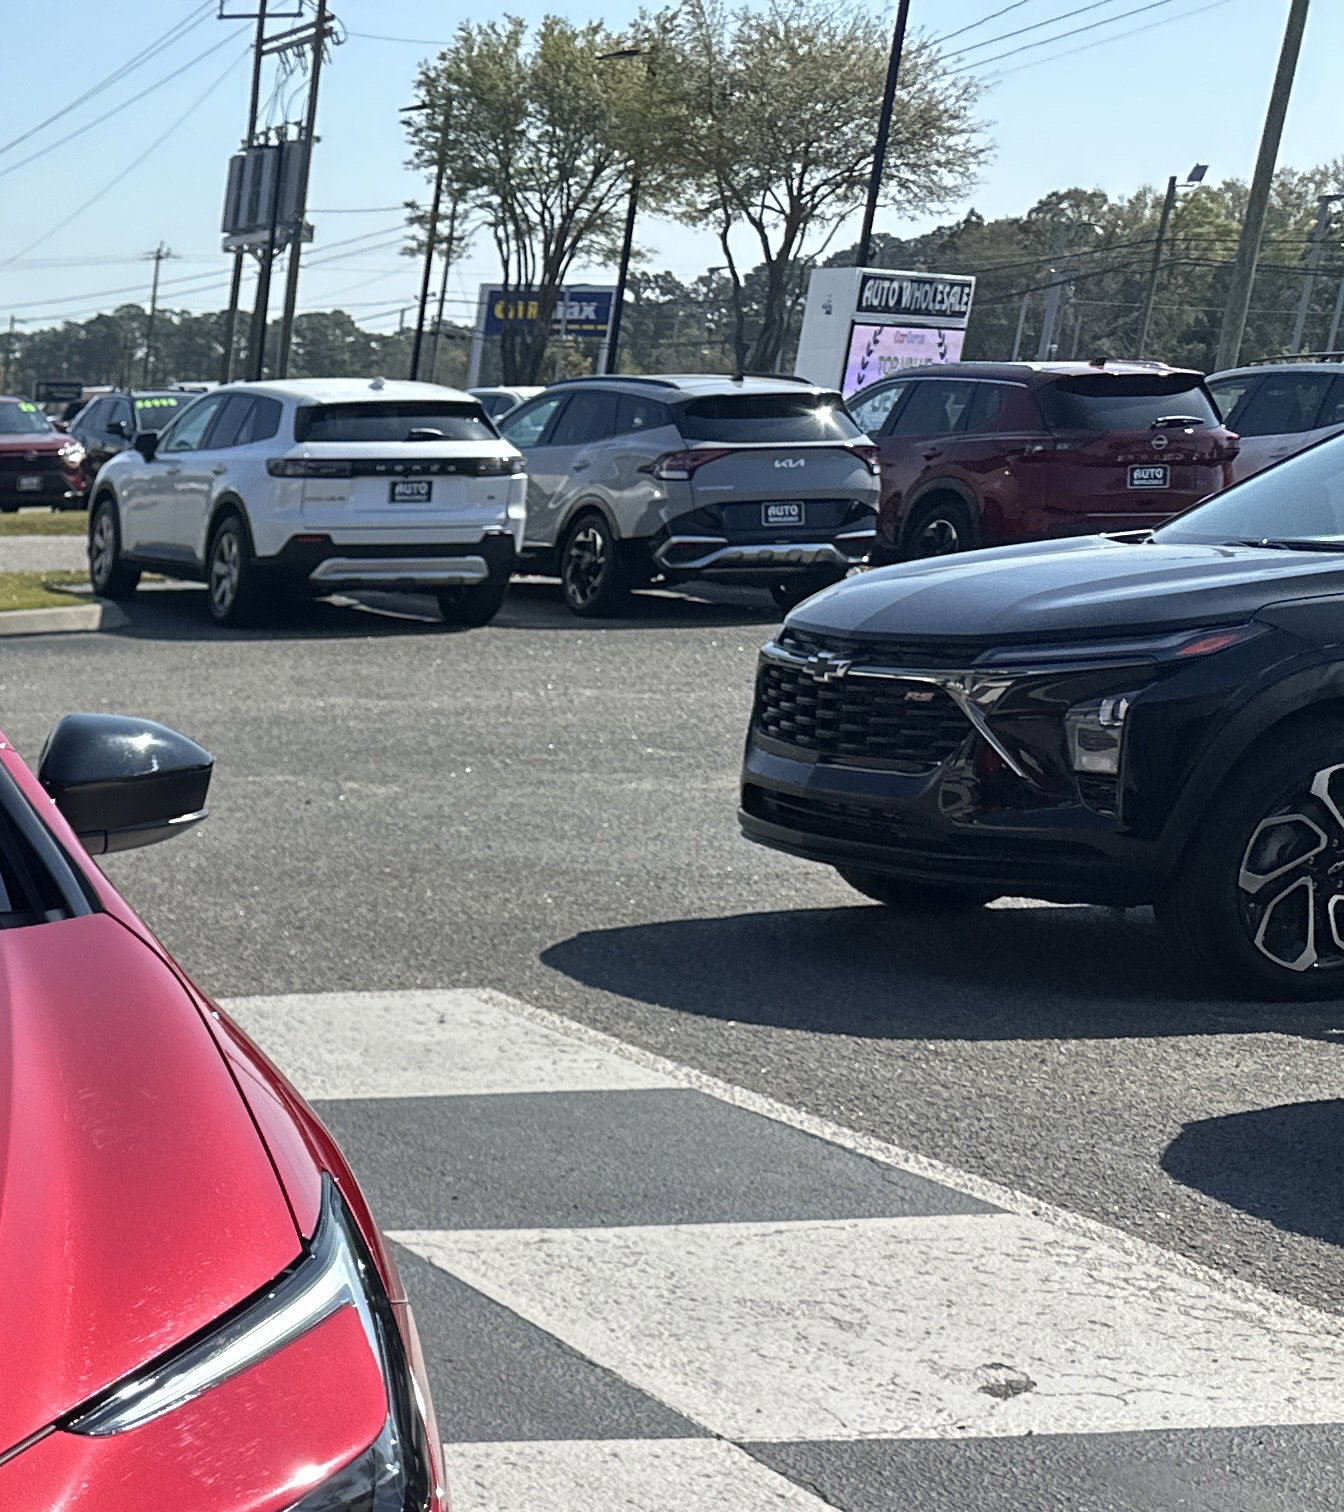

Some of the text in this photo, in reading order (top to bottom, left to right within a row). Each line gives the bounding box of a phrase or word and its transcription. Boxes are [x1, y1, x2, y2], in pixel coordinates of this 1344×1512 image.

[862, 278, 970, 315] AUTO WHOLESALE
[1132, 468, 1164, 480] AUTO
[394, 482, 428, 496] AUTO
[767, 505, 799, 516] AUTO
